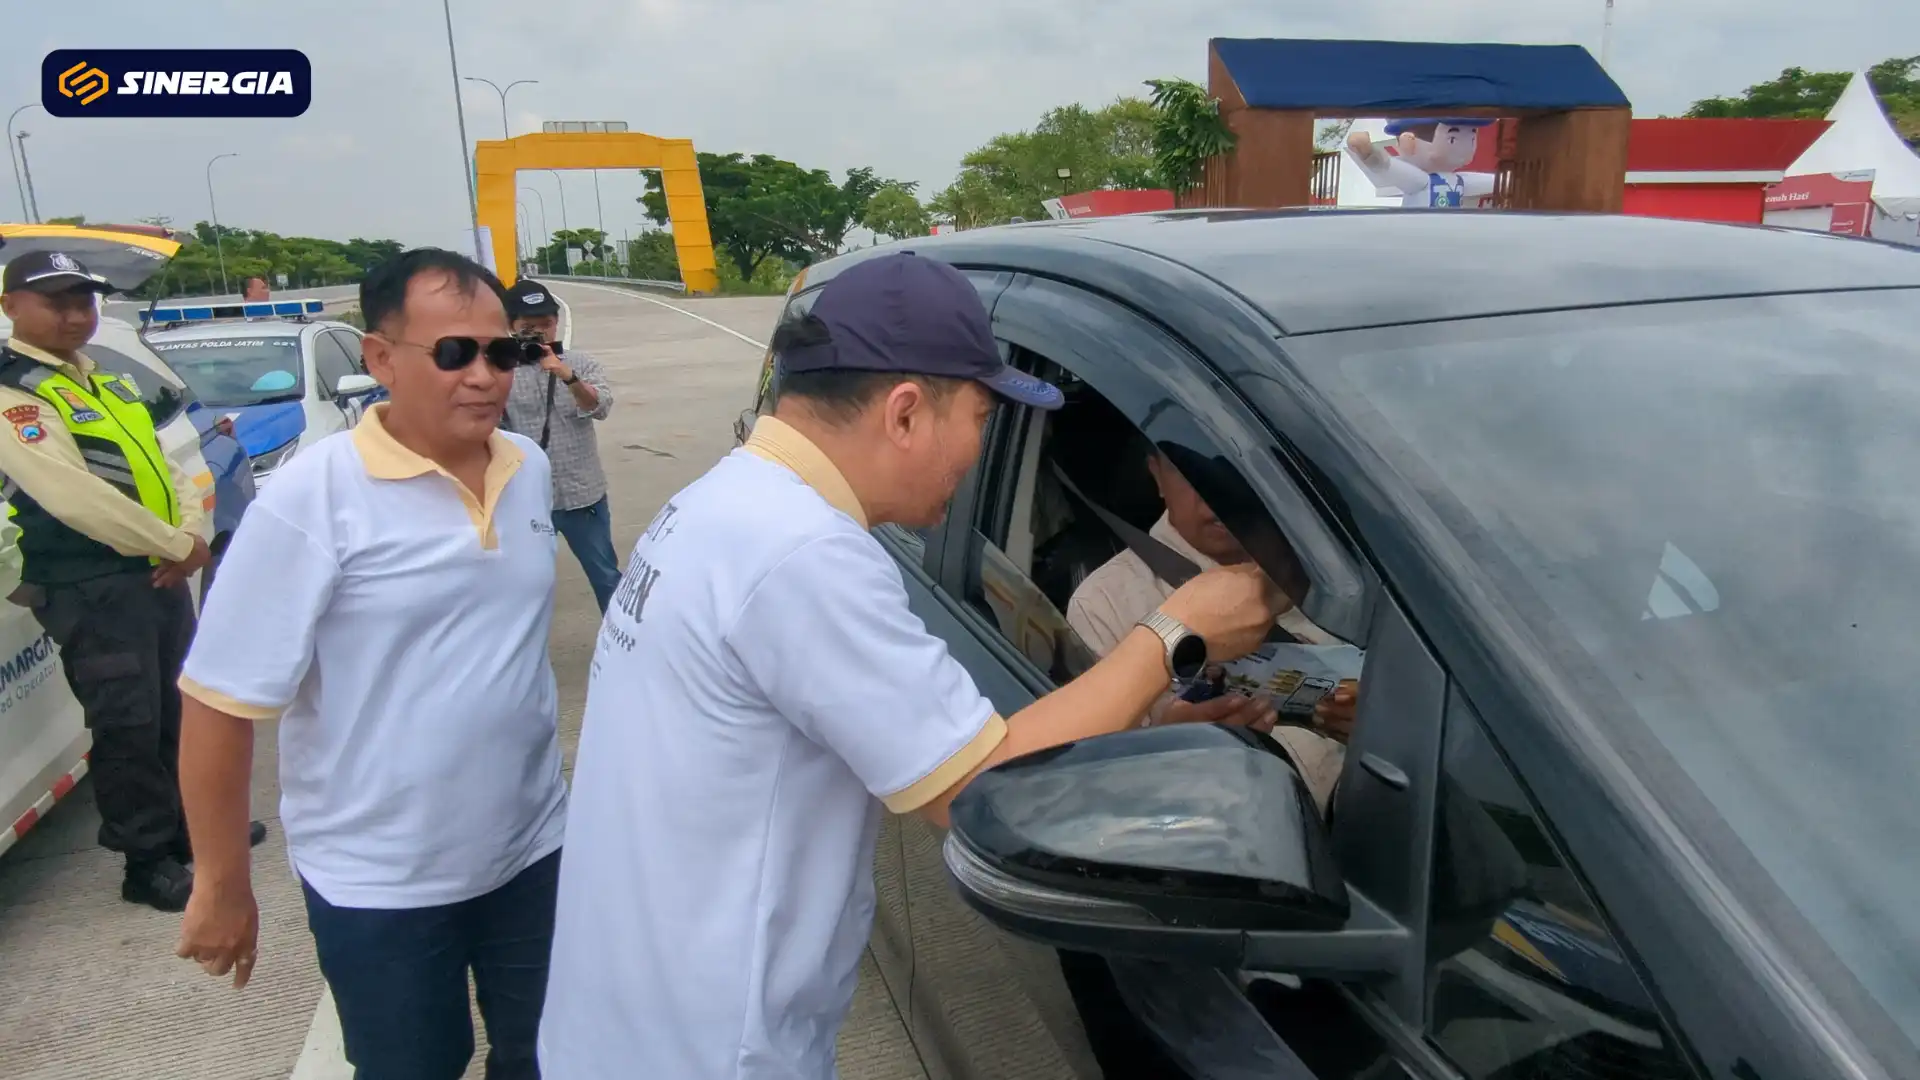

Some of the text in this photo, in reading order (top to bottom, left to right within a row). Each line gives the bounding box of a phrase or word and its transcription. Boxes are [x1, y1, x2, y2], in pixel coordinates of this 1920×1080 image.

[1789, 192, 1810, 201] Hati
[200, 340, 232, 348] POLDA
[0, 635, 54, 694] MARGA
[16, 660, 57, 700] Operator
